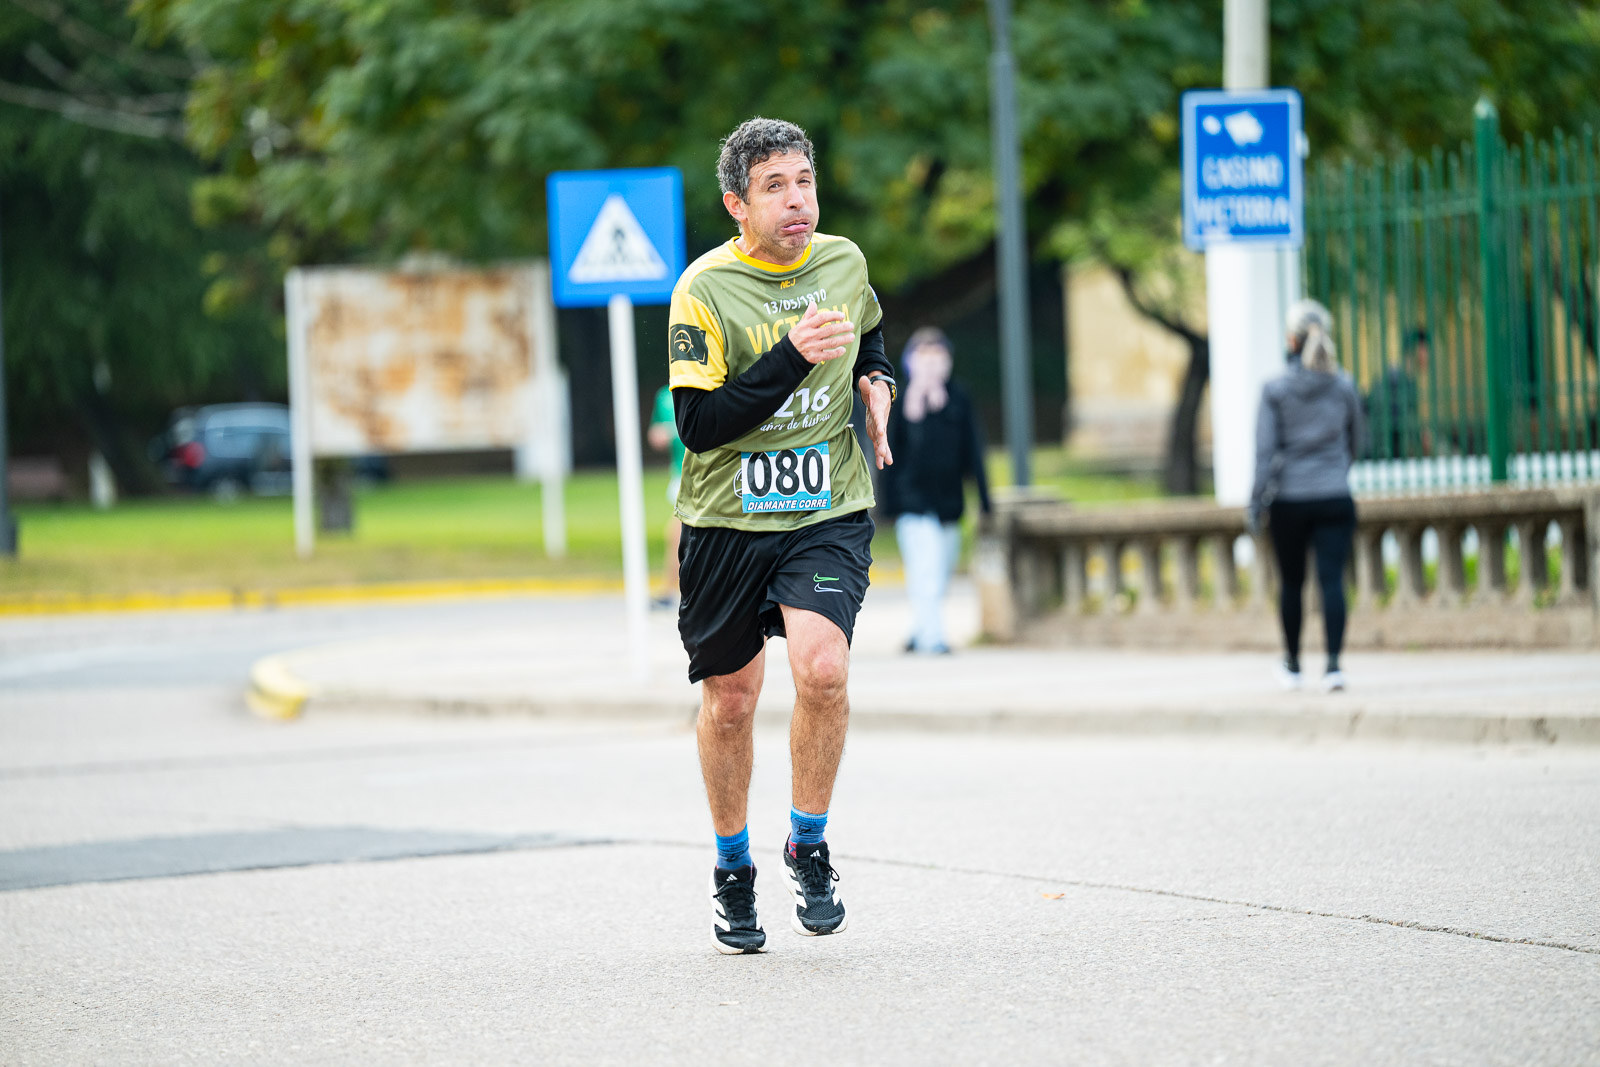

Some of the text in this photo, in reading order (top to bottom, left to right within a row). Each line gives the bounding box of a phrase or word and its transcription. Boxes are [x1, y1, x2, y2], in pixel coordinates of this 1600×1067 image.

[1202, 154, 1284, 190] CASINO
[1192, 194, 1294, 228] VICTORIA
[763, 288, 827, 315] 13/05/1810
[773, 385, 831, 418] 216
[787, 418, 800, 430] de
[747, 447, 824, 498] 080
[747, 498, 828, 511] DIAMANTE CORRE
